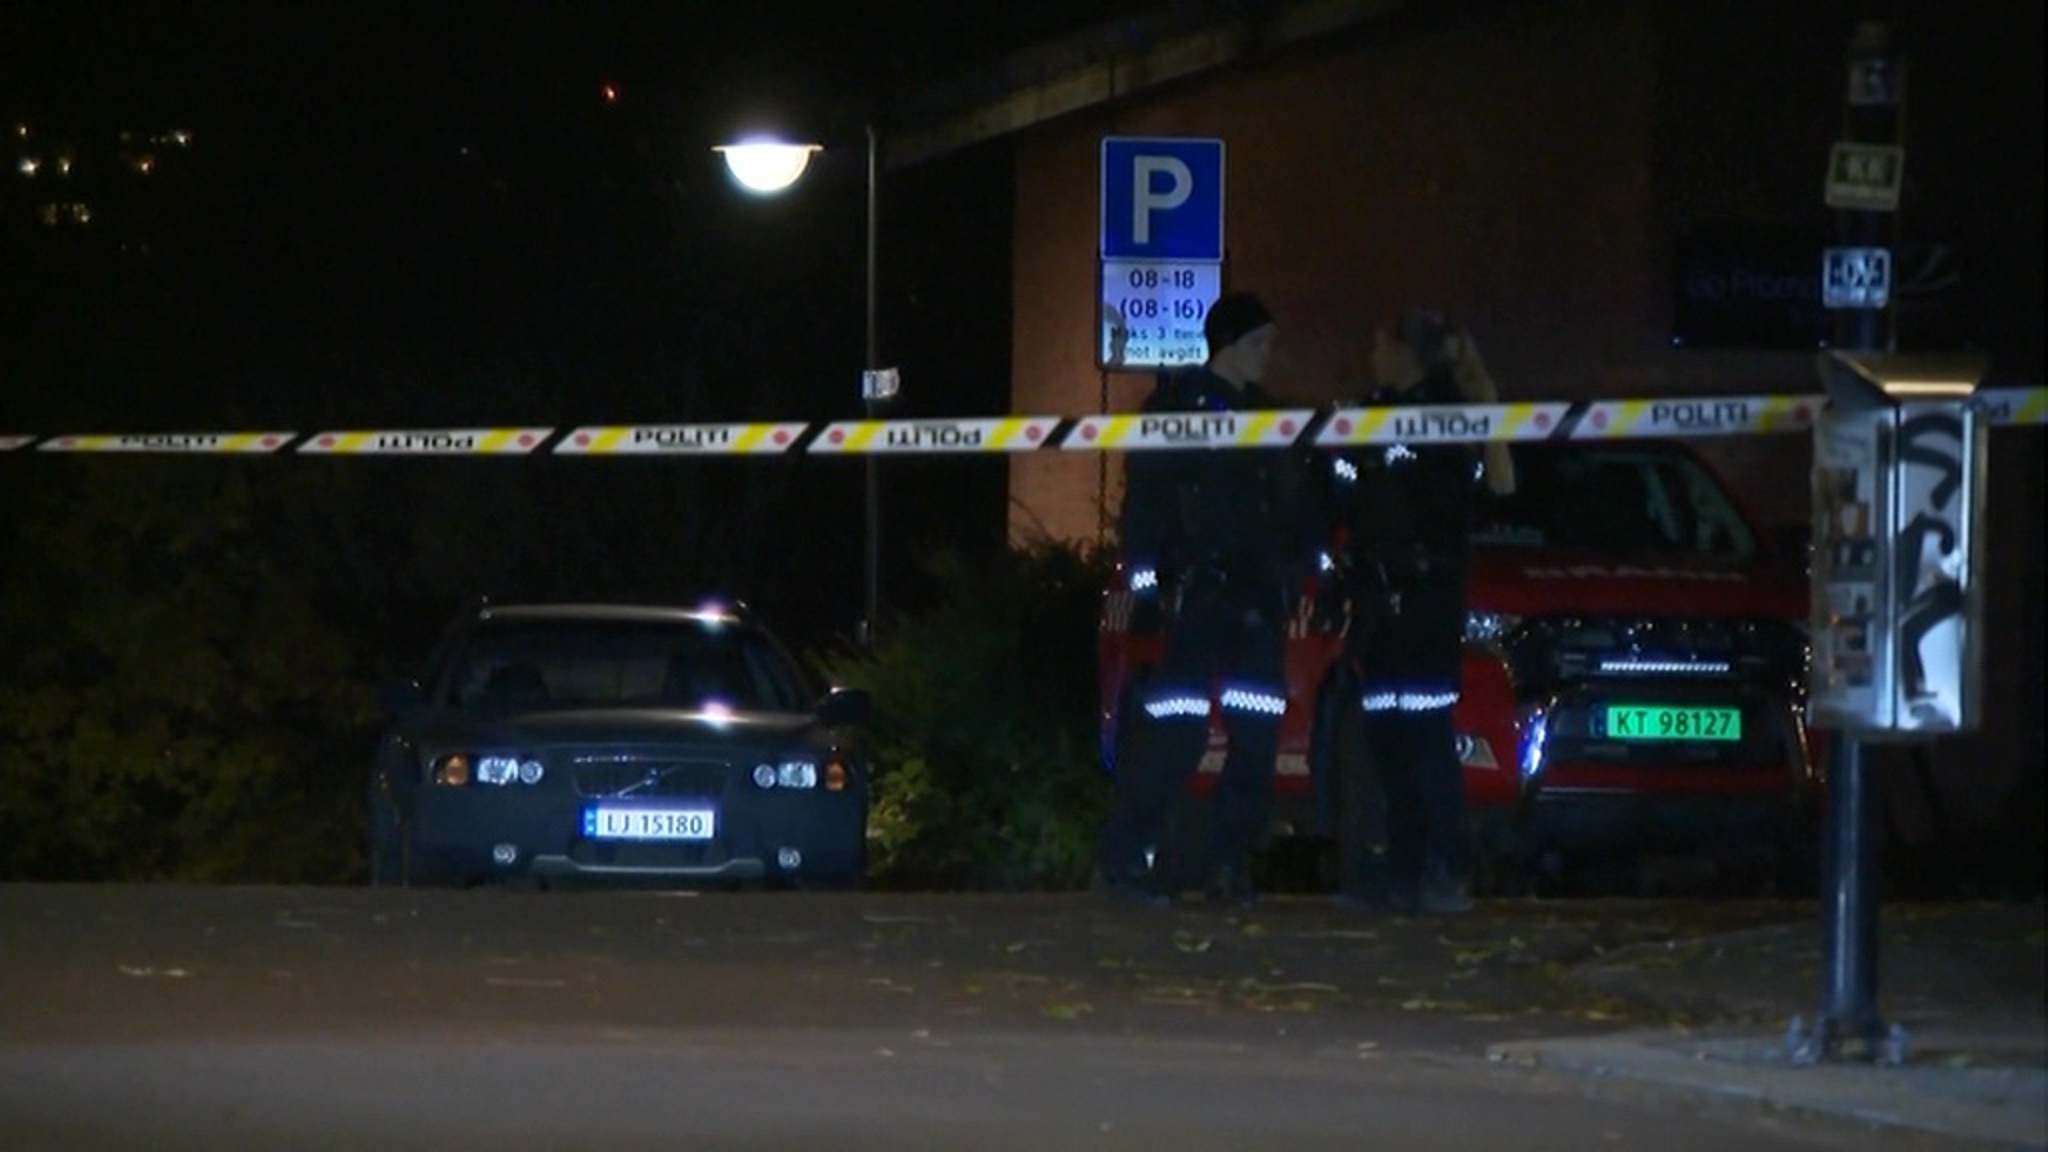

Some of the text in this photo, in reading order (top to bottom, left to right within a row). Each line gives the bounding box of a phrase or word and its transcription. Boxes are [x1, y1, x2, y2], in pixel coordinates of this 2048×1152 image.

[1131, 153, 1195, 246] P
[1128, 268, 1196, 289] 08-18
[1119, 298, 1205, 320] (08-16)
[1157, 326, 1166, 340] 3
[1141, 414, 1236, 436] POLITI
[1394, 414, 1490, 436] POLITI
[1651, 402, 1748, 426] POLITI
[634, 428, 729, 444] POLITI
[888, 428, 981, 445] POLITI
[1616, 710, 1733, 736] KT 98127
[607, 813, 704, 835] LJ 15180
